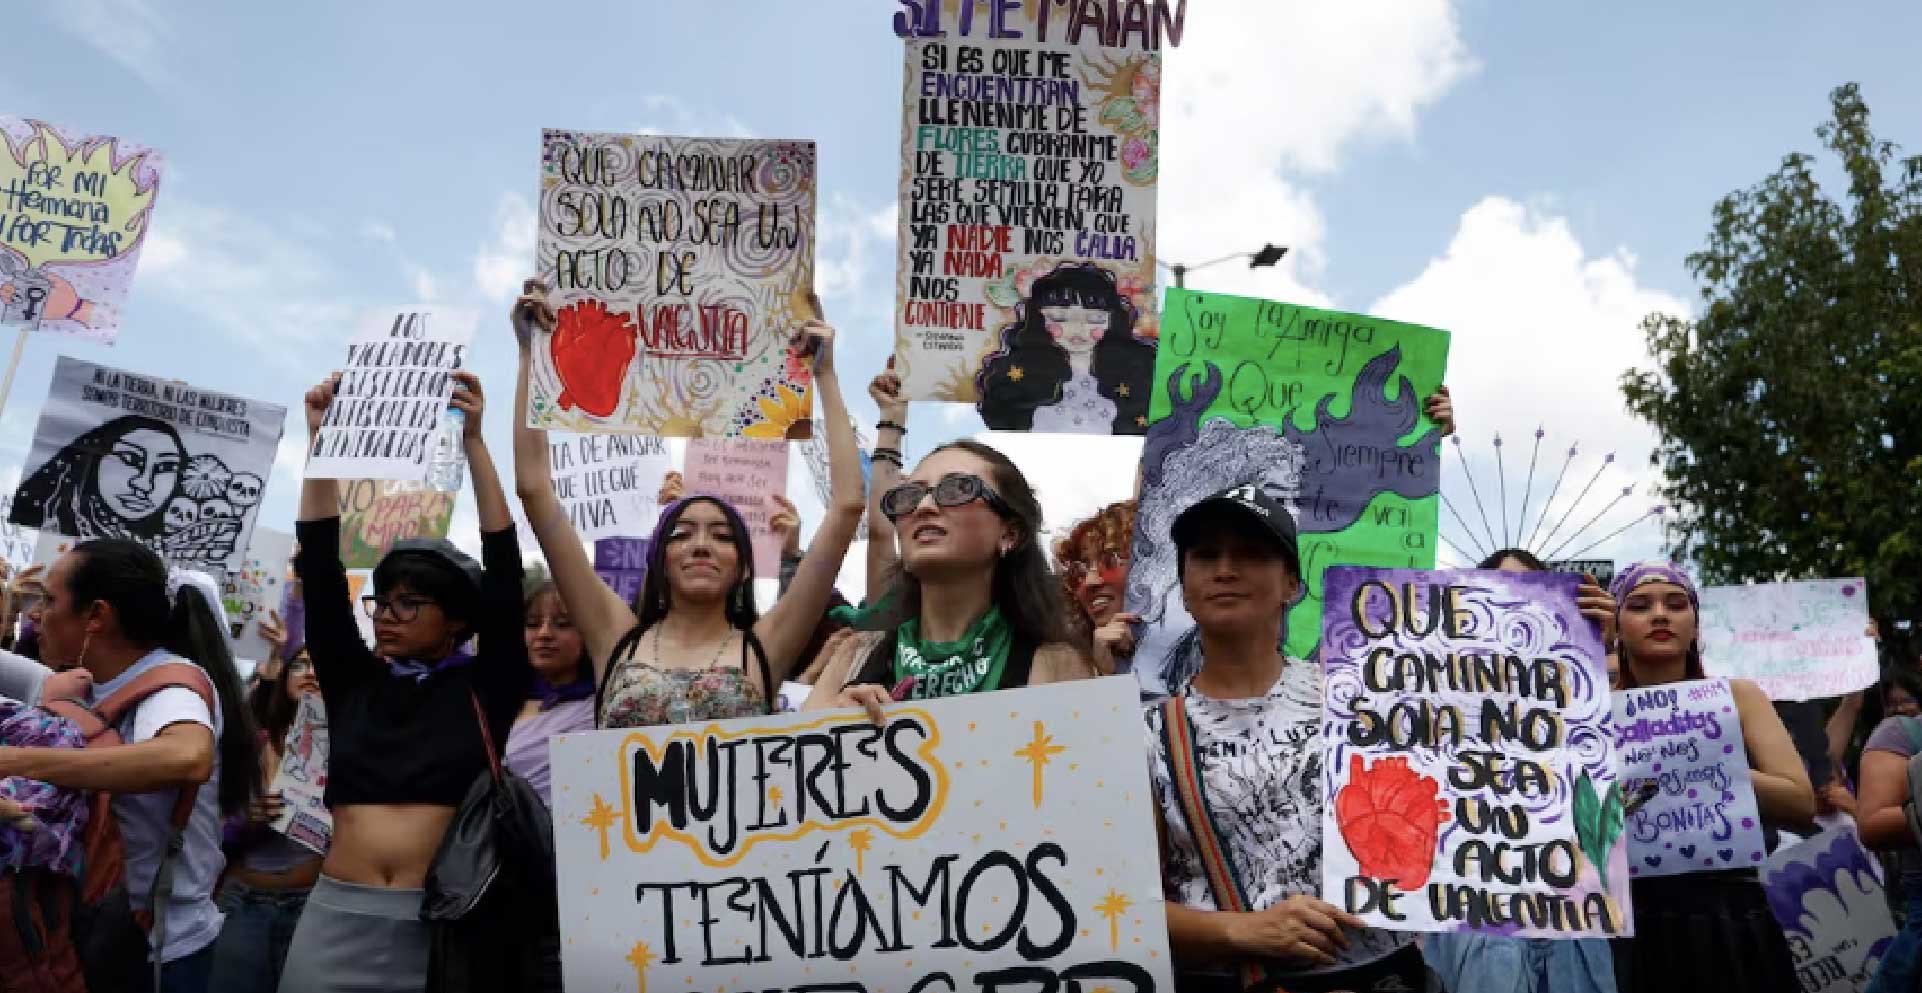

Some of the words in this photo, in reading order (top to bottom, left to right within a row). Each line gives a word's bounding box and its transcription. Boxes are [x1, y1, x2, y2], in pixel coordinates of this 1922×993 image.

[922, 42, 947, 70] SI
[956, 46, 984, 73] ES
[992, 49, 1033, 77] QUE
[1037, 51, 1072, 79] ME
[920, 72, 1079, 106] ENCUENTRAN
[918, 98, 1048, 131] LLENENME
[1056, 106, 1088, 134] DE
[1006, 132, 1118, 161] CUBRANME
[561, 147, 616, 187] QUE
[638, 150, 758, 193] CAMINAR
[916, 150, 945, 176] DE
[953, 151, 1026, 181] TIERRA
[1033, 158, 1071, 183] QUE
[1079, 161, 1105, 185] YO
[911, 178, 963, 202] SERE
[974, 179, 1057, 207] SEMILLA
[1067, 185, 1123, 213] PARA
[557, 192, 628, 240] SOLA
[638, 200, 683, 244] NO
[689, 199, 740, 247] SEA
[758, 204, 799, 249] UN
[911, 202, 949, 224] LAS
[955, 204, 990, 225] QUE
[1094, 213, 1130, 235] QUE
[910, 224, 938, 249] YA
[947, 224, 1014, 253] NADIE
[1024, 228, 1064, 255] NOS
[557, 249, 629, 291] ACTO
[656, 251, 696, 296] DE
[909, 250, 934, 276] YA
[943, 251, 1002, 279] NADA
[909, 276, 960, 302] NOS
[904, 301, 985, 331] CONTIENE
[177, 386, 197, 404] LAS
[199, 393, 247, 416] MUJERES
[178, 406, 192, 424] DE
[579, 436, 605, 464] DE
[1351, 581, 1479, 641] QUE
[911, 657, 991, 699] ERECHO
[1363, 647, 1569, 708] CAMINAR
[1347, 698, 1464, 749] SOLA
[1481, 698, 1564, 750] NO
[634, 718, 933, 855] MUJERES
[1450, 750, 1555, 797] SEA
[1455, 797, 1530, 840] UN
[1453, 839, 1582, 889] ACTO
[636, 841, 1078, 967] TENÍAMOS
[1344, 876, 1406, 921] DE
[1428, 883, 1623, 933] VALENTIA
